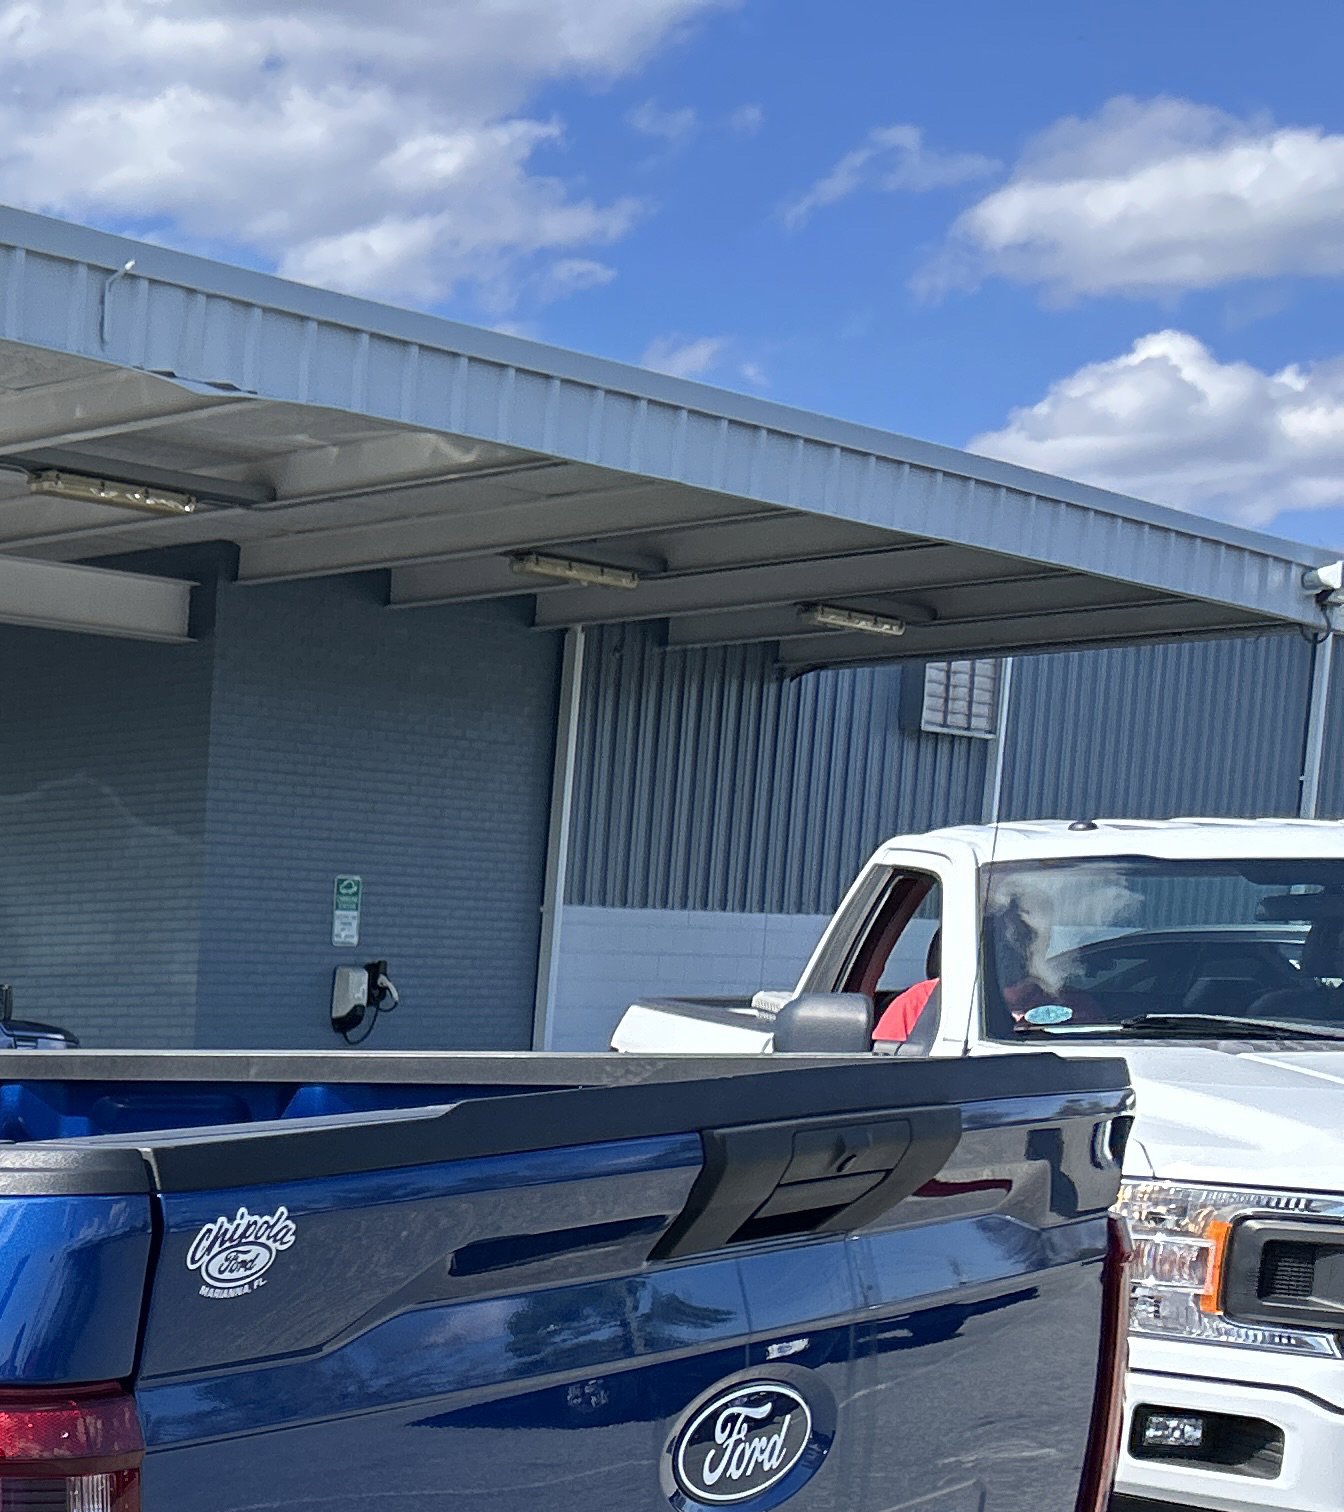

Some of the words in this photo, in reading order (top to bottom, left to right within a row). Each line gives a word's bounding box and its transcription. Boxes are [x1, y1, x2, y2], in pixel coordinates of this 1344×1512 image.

[188, 1208, 296, 1269] Chipola
[218, 1249, 261, 1275] Ford
[703, 1402, 792, 1485] Ford
